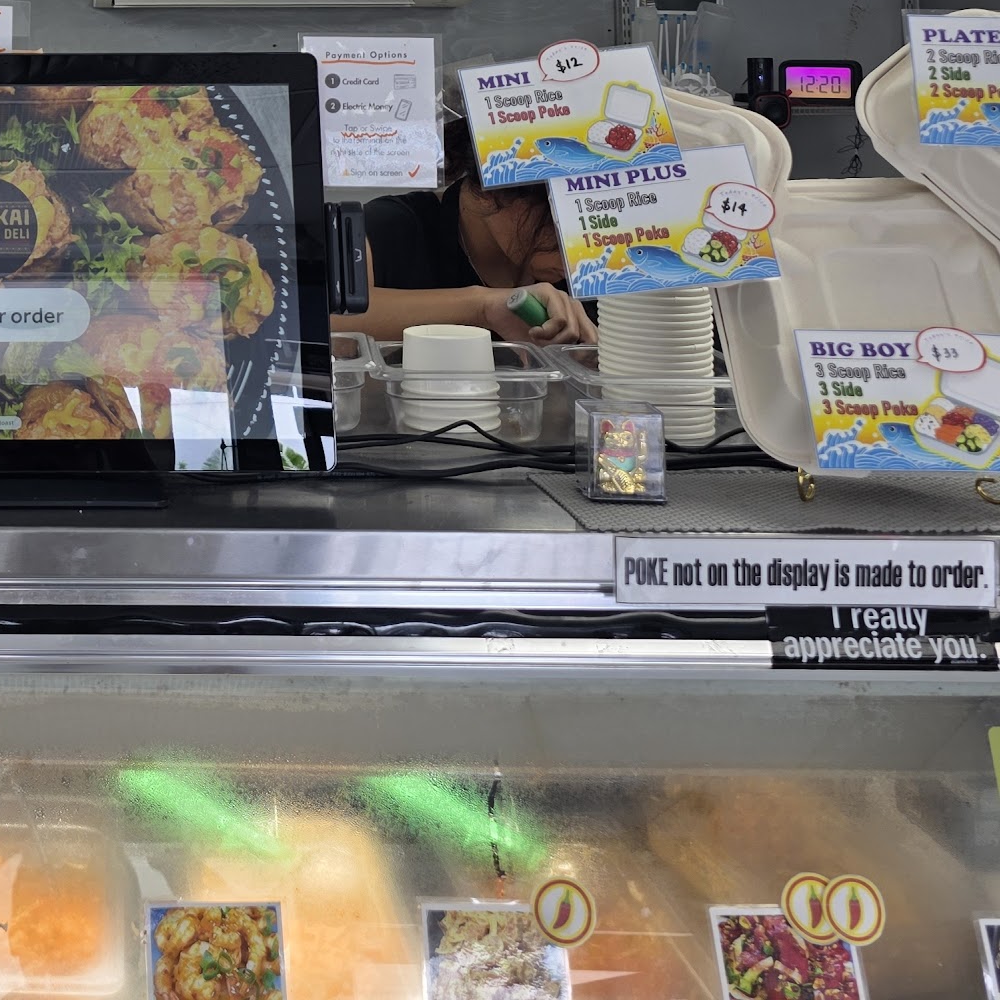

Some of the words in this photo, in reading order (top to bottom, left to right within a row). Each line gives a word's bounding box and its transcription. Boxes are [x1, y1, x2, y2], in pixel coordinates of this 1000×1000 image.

[921, 29, 1000, 43] PLATE
[326, 51, 366, 60] Payment
[370, 51, 407, 60] Options
[926, 49, 935, 63] 2
[938, 49, 981, 67] Scoop
[556, 57, 583, 74] $12
[928, 66, 937, 80] 2
[940, 66, 970, 81] Side
[477, 72, 531, 90] MINI
[800, 76, 841, 94] 12:20
[494, 92, 533, 109] Scoop
[534, 89, 563, 104] Rice
[930, 83, 939, 97] 2
[942, 83, 985, 102] Scoop
[498, 107, 536, 124] Scoop
[538, 104, 570, 119] Poke
[565, 172, 621, 192] MINI
[627, 163, 687, 184] PLUS
[586, 195, 625, 213] Scoop
[627, 191, 658, 207] Rice
[721, 197, 747, 216] $14
[588, 214, 618, 229] Side
[4, 228, 30, 240] DELI
[592, 230, 633, 248] Scoop
[635, 225, 670, 242] Poke
[10, 307, 64, 324] order
[809, 341, 855, 357] BIG
[859, 342, 912, 357] BOY
[815, 363, 825, 378] 3
[827, 363, 870, 382] Scoop
[873, 364, 906, 379] Rice
[818, 381, 828, 396] 3
[831, 381, 863, 397] Side
[822, 399, 832, 414] 3
[835, 399, 879, 419] Scoop
[881, 400, 919, 416] Poke
[624, 557, 668, 586] POKE
[673, 560, 702, 586] not
[708, 564, 727, 586] on
[733, 558, 761, 586] the
[767, 558, 828, 591] display
[834, 558, 850, 587] is
[855, 560, 902, 587] made
[909, 561, 926, 587] to
[932, 560, 988, 589] order.
[831, 606, 841, 629] I
[851, 606, 928, 636] really
[783, 631, 922, 663] appreciate
[931, 635, 987, 664] you.
